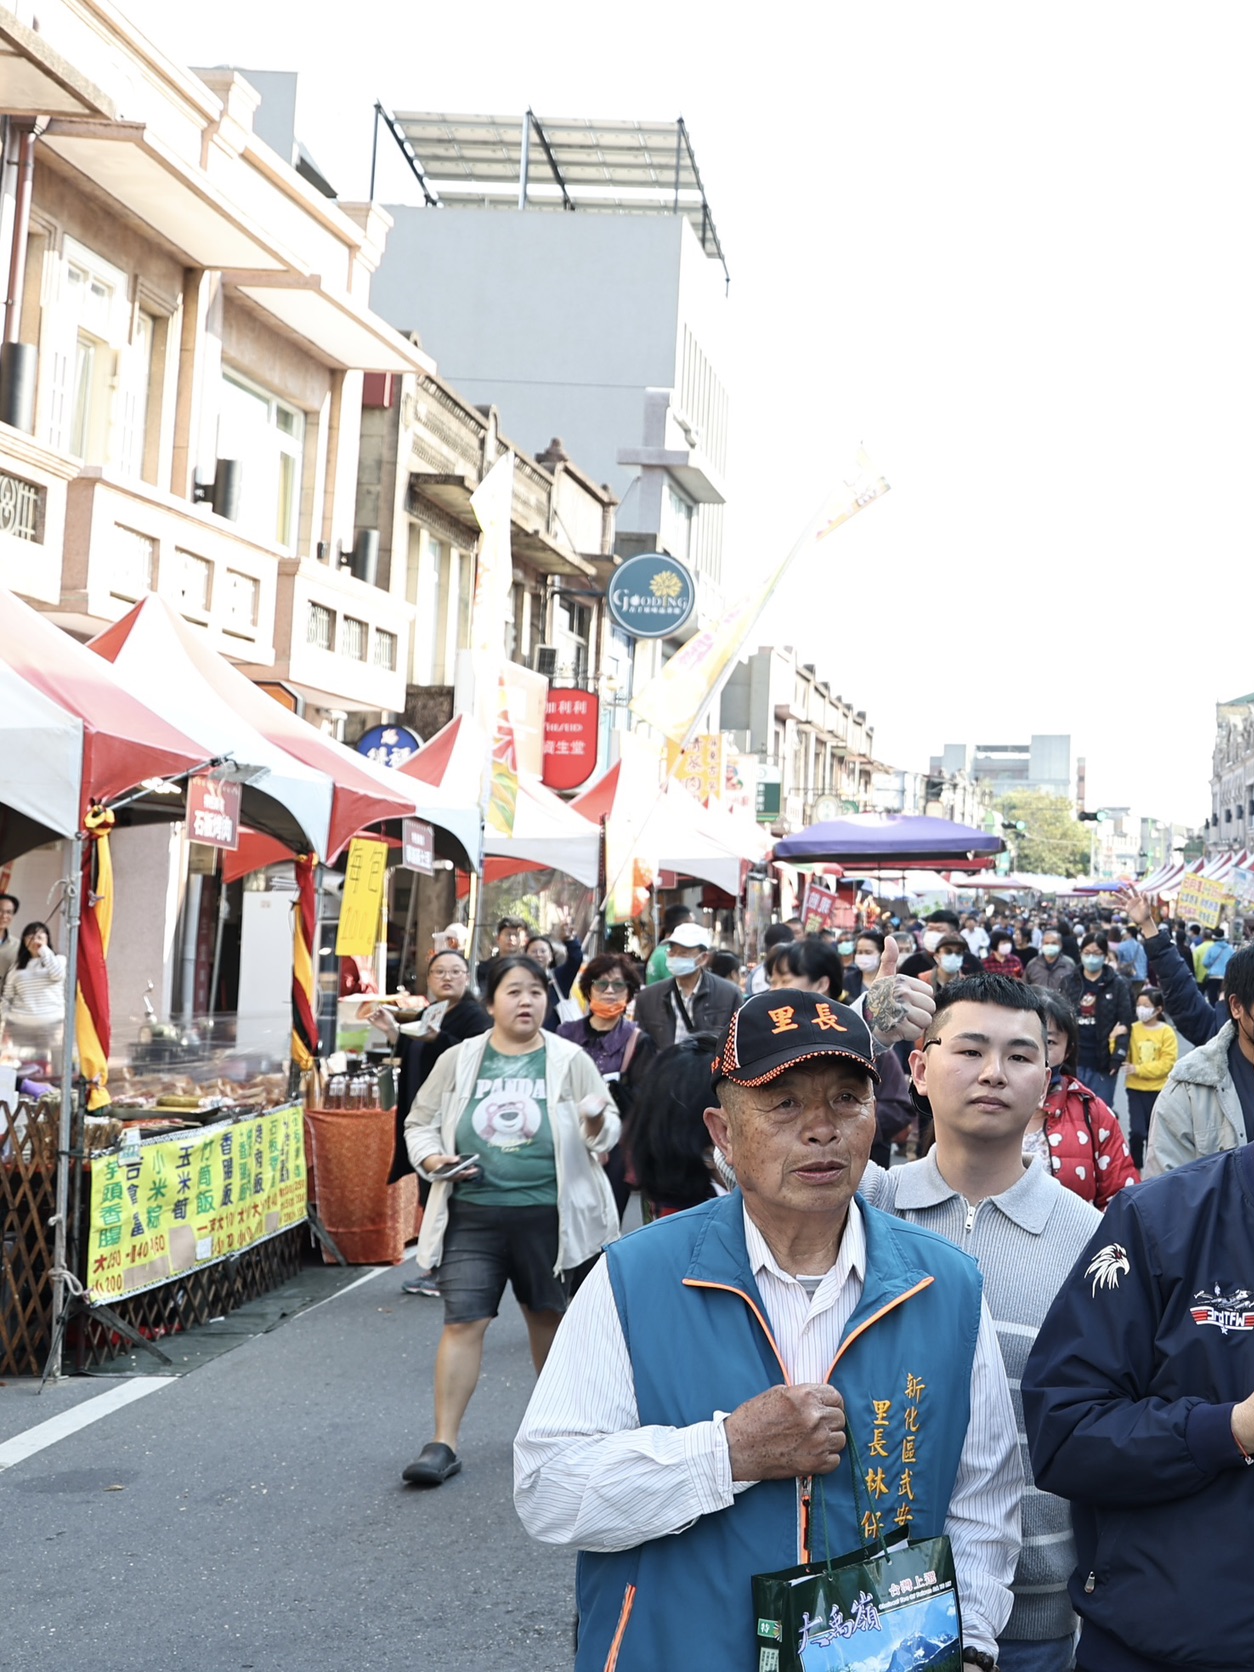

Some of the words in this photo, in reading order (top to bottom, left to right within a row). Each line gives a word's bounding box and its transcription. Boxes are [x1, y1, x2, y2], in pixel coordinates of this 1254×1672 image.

[768, 1003, 848, 1035] 里長
[474, 1077, 547, 1099] PANDA
[98, 1161, 122, 1248] 芋頭香腸
